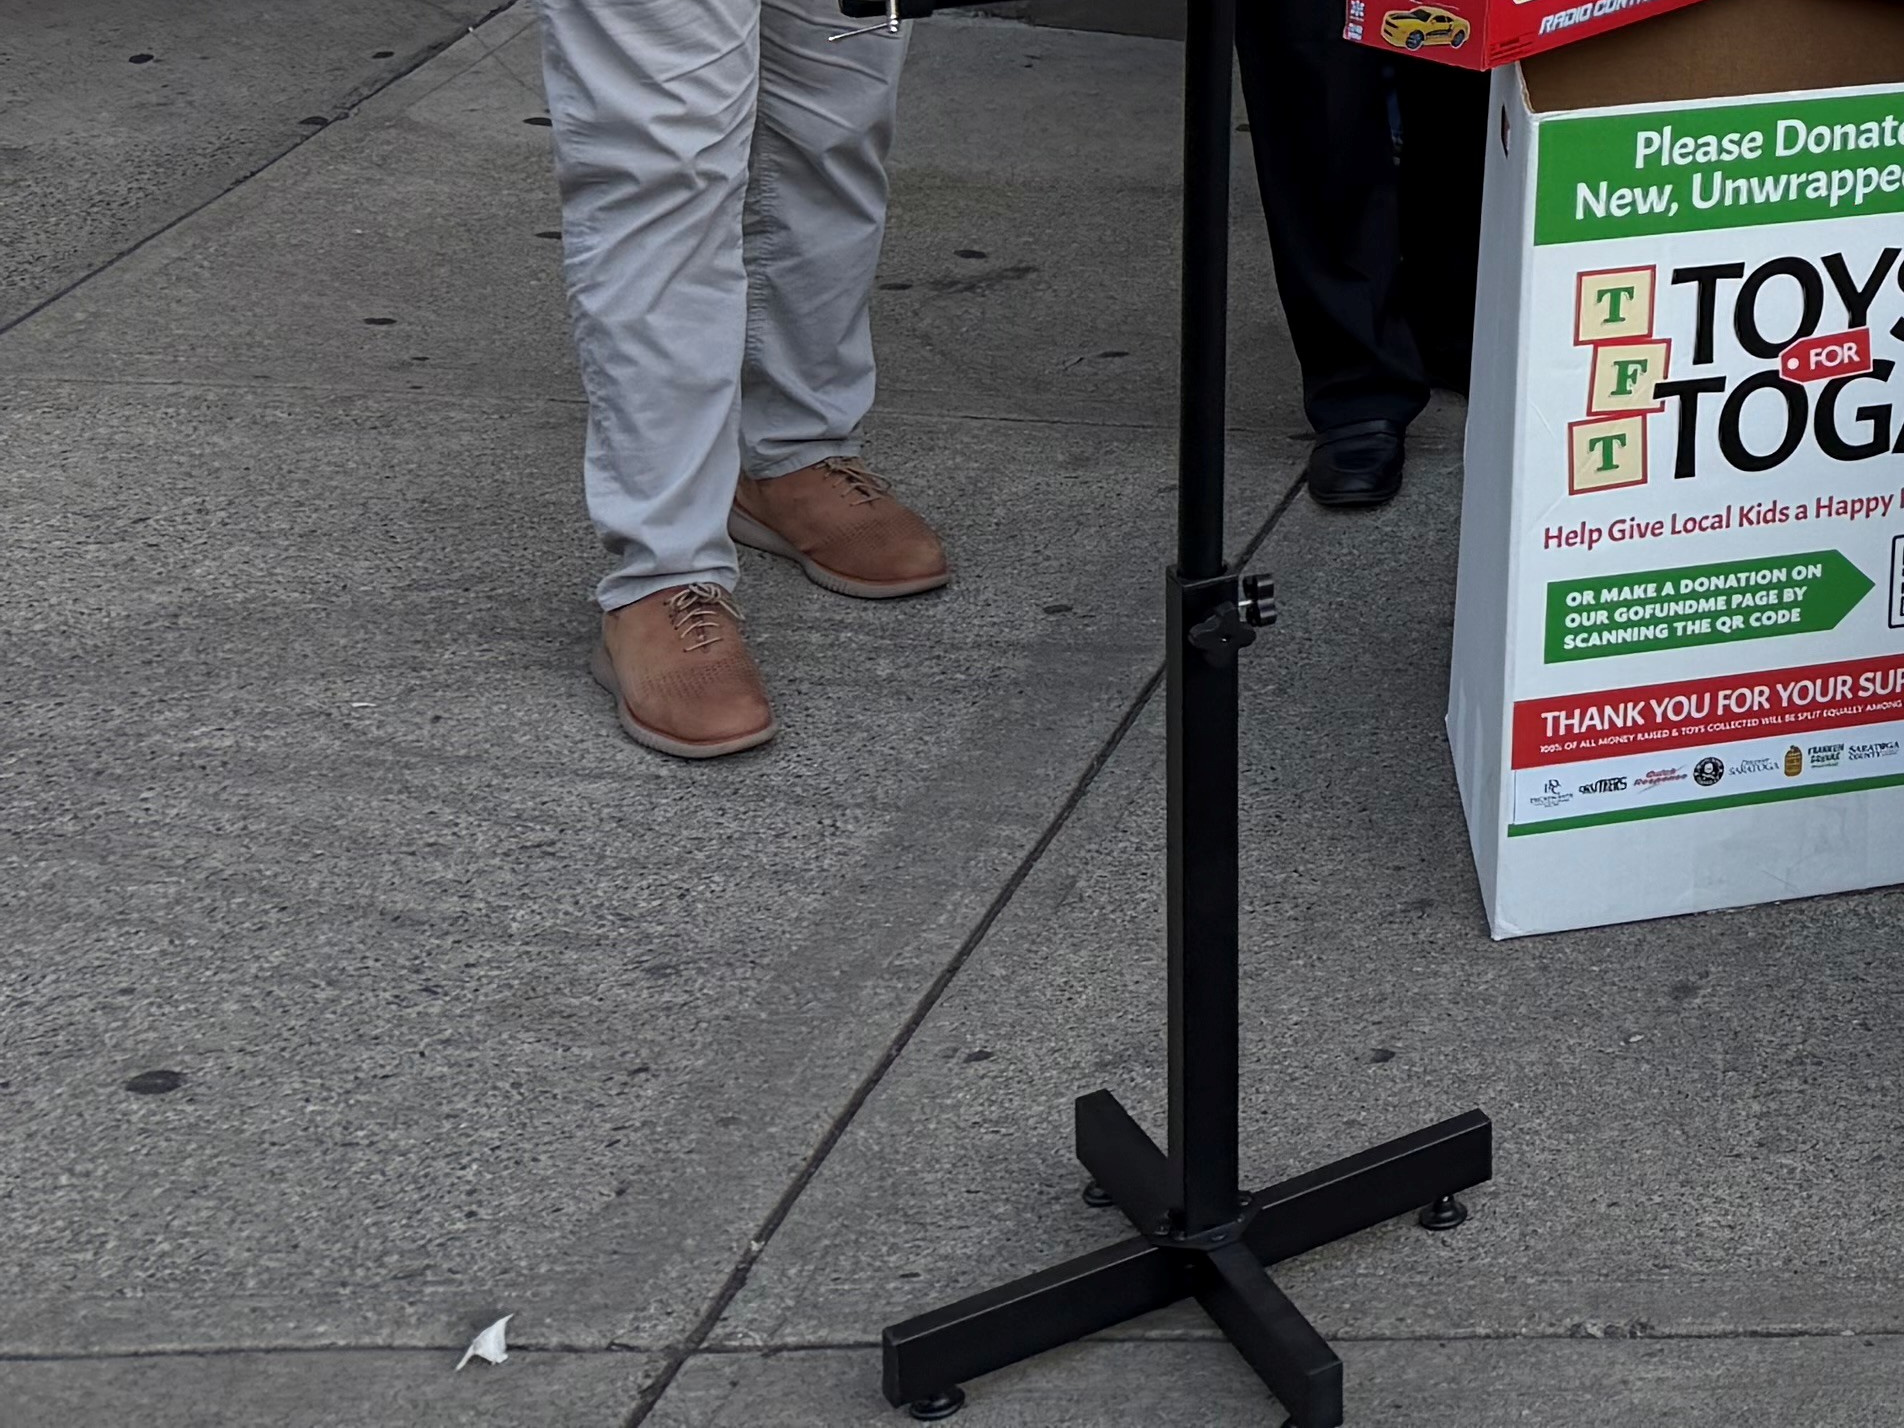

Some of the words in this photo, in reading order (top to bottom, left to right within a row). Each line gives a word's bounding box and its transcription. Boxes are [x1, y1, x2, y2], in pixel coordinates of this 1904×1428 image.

[1635, 125, 1763, 169] Please
[1576, 181, 1678, 220] New,
[1810, 342, 1860, 370] FOR
[1541, 702, 1647, 737] THANK
[1650, 692, 1710, 723] YOU
[1717, 686, 1770, 715] FOR
[1776, 675, 1853, 707] YOUR
